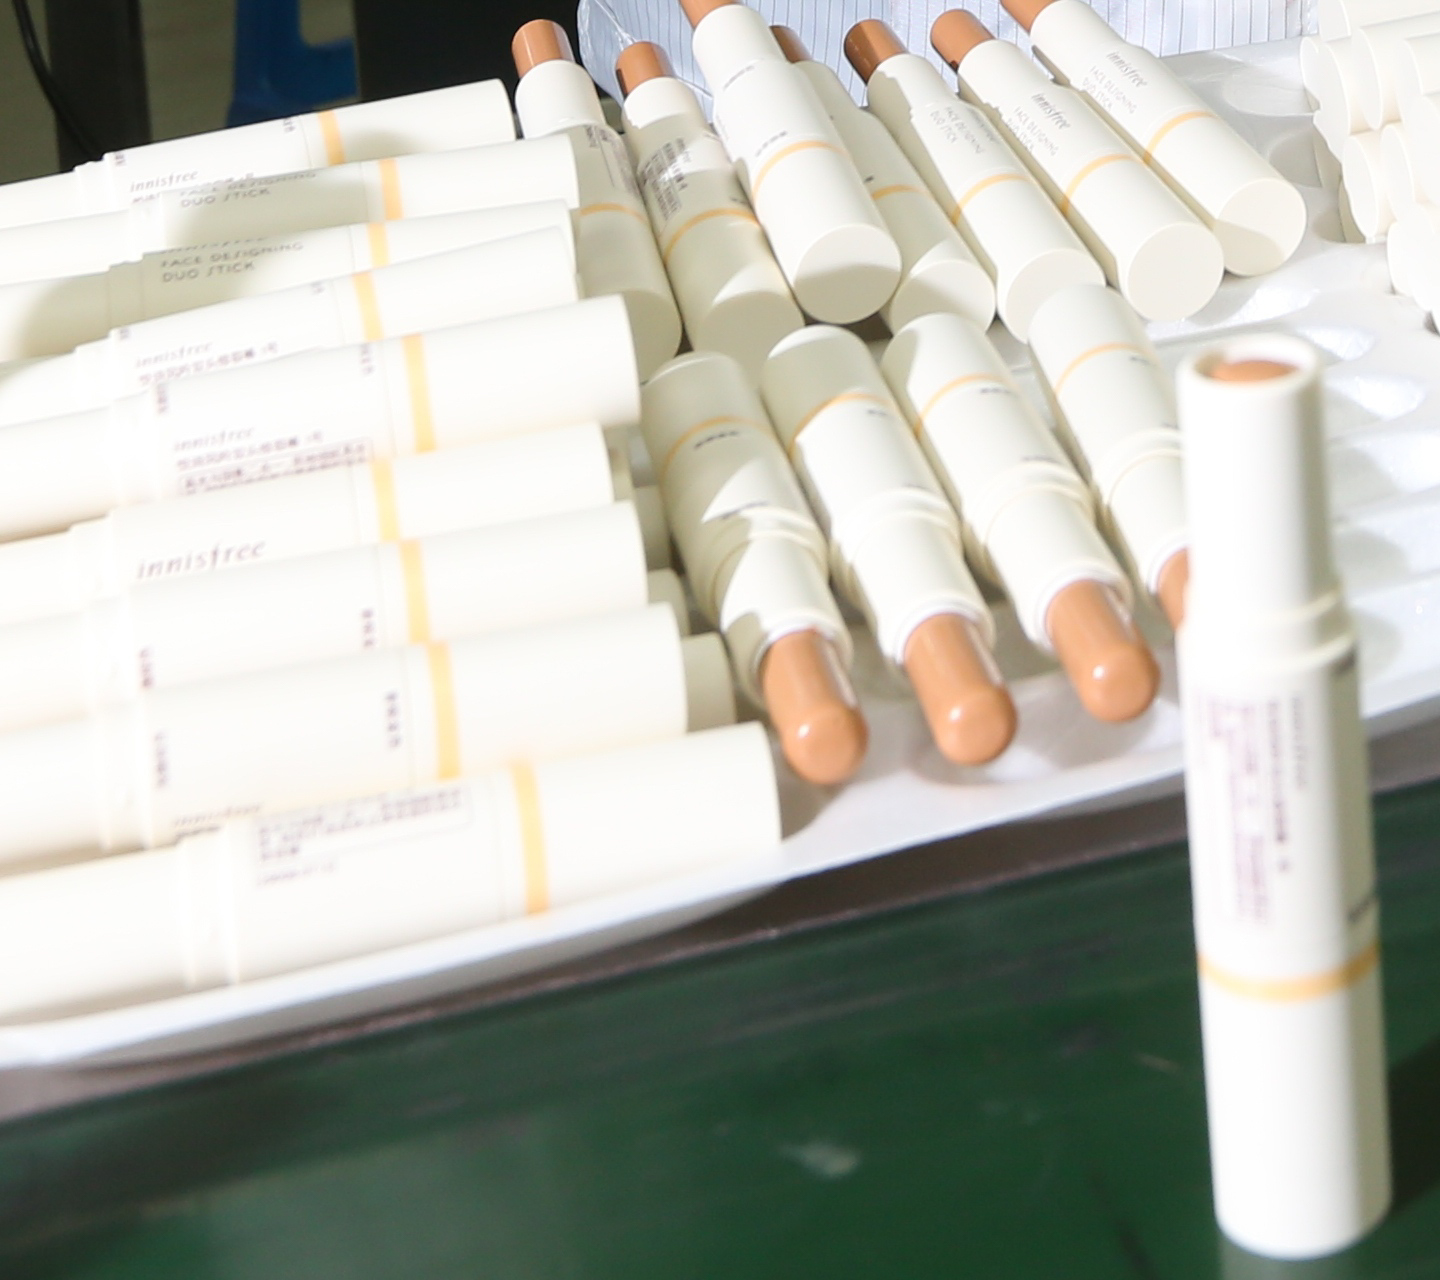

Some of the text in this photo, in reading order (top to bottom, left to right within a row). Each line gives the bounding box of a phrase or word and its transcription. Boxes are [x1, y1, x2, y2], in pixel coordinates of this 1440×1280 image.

[1106, 51, 1148, 88] innisfree
[1031, 92, 1072, 130] innisfree
[130, 170, 199, 192] innisfree
[180, 187, 271, 209] DUO STICK
[161, 255, 203, 269] FACE
[210, 241, 305, 263] DESIGNING
[162, 261, 256, 284] DUO STICK
[135, 342, 213, 368] innisfree
[137, 540, 266, 580] innisfree
